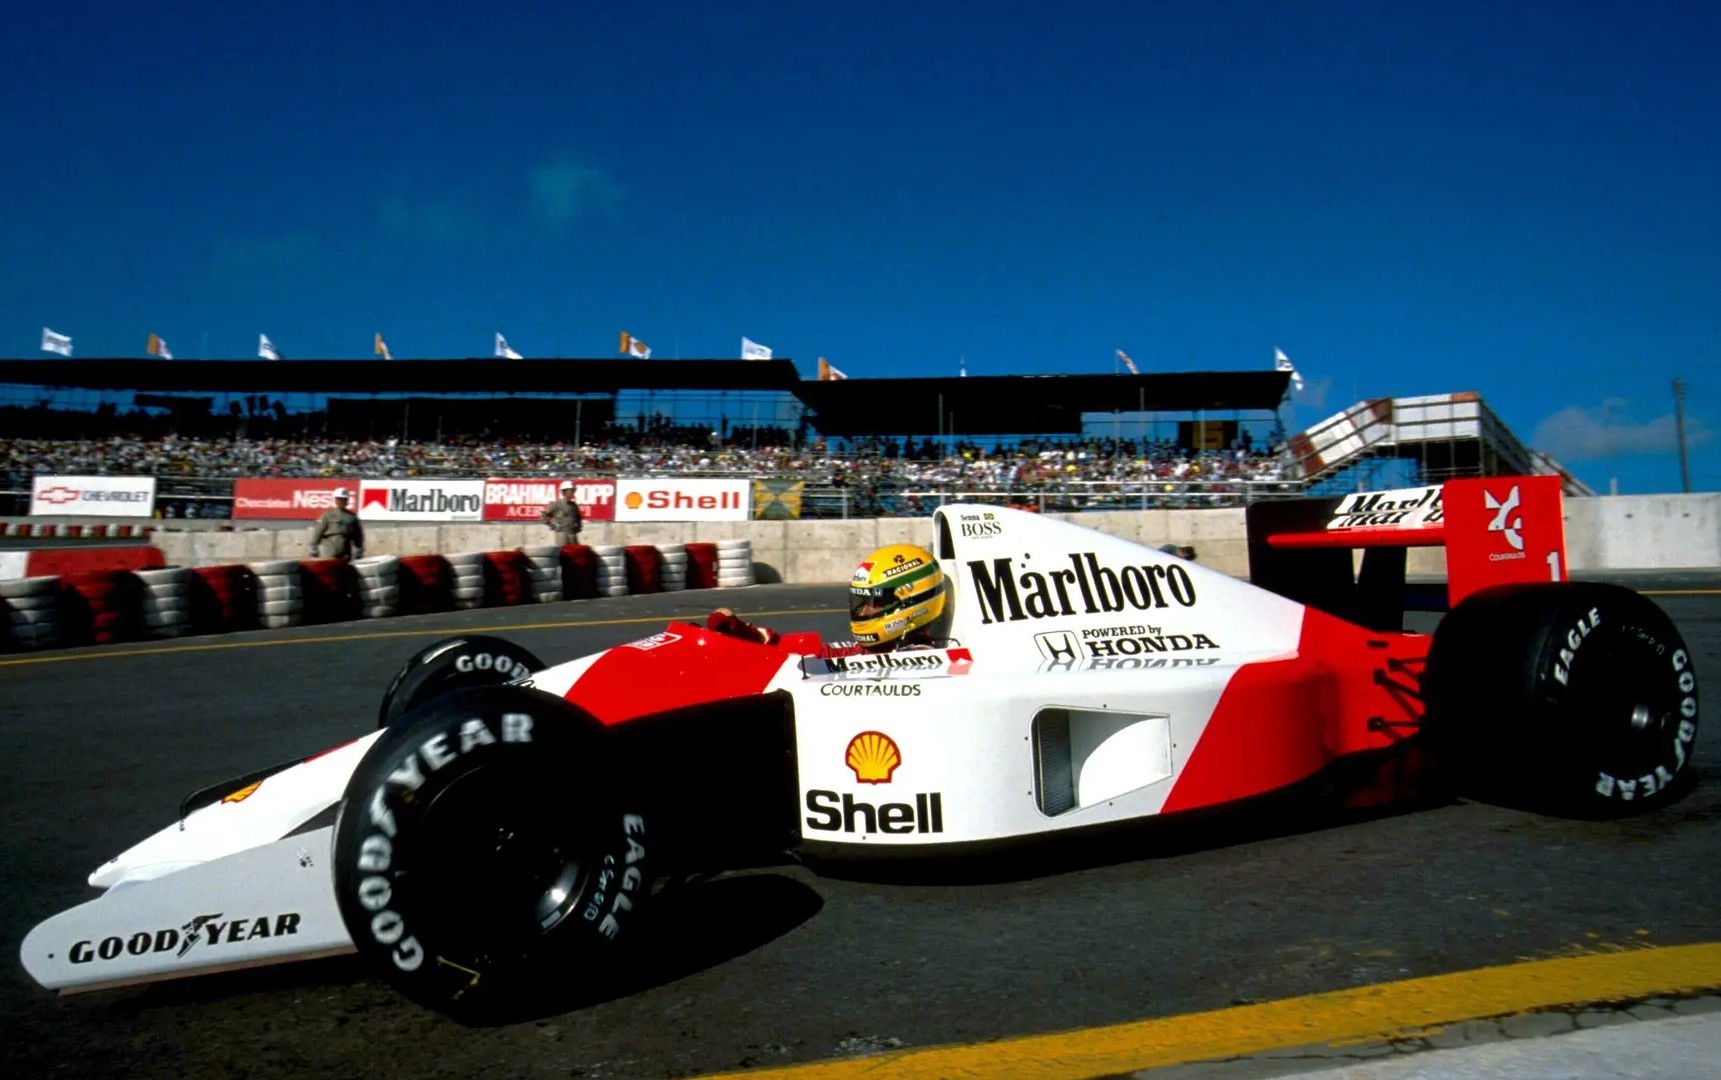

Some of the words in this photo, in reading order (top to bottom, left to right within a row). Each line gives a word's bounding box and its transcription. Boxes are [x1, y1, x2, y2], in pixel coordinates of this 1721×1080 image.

[389, 488, 480, 512] Marlboro
[486, 483, 556, 505] BRAHMA
[647, 490, 740, 509] Shell
[961, 521, 1002, 537] BOSS
[1546, 551, 1560, 582] 1
[967, 552, 1197, 625] Marlboro
[1082, 626, 1146, 639] POWERED
[1148, 625, 1162, 635] by
[1085, 634, 1220, 657] HONDA
[1554, 607, 1601, 686] EAGLE
[824, 654, 943, 673] Marlboro
[820, 683, 921, 696] COURTAULDS
[806, 789, 944, 834] Shell
[598, 813, 646, 940] EAGLE
